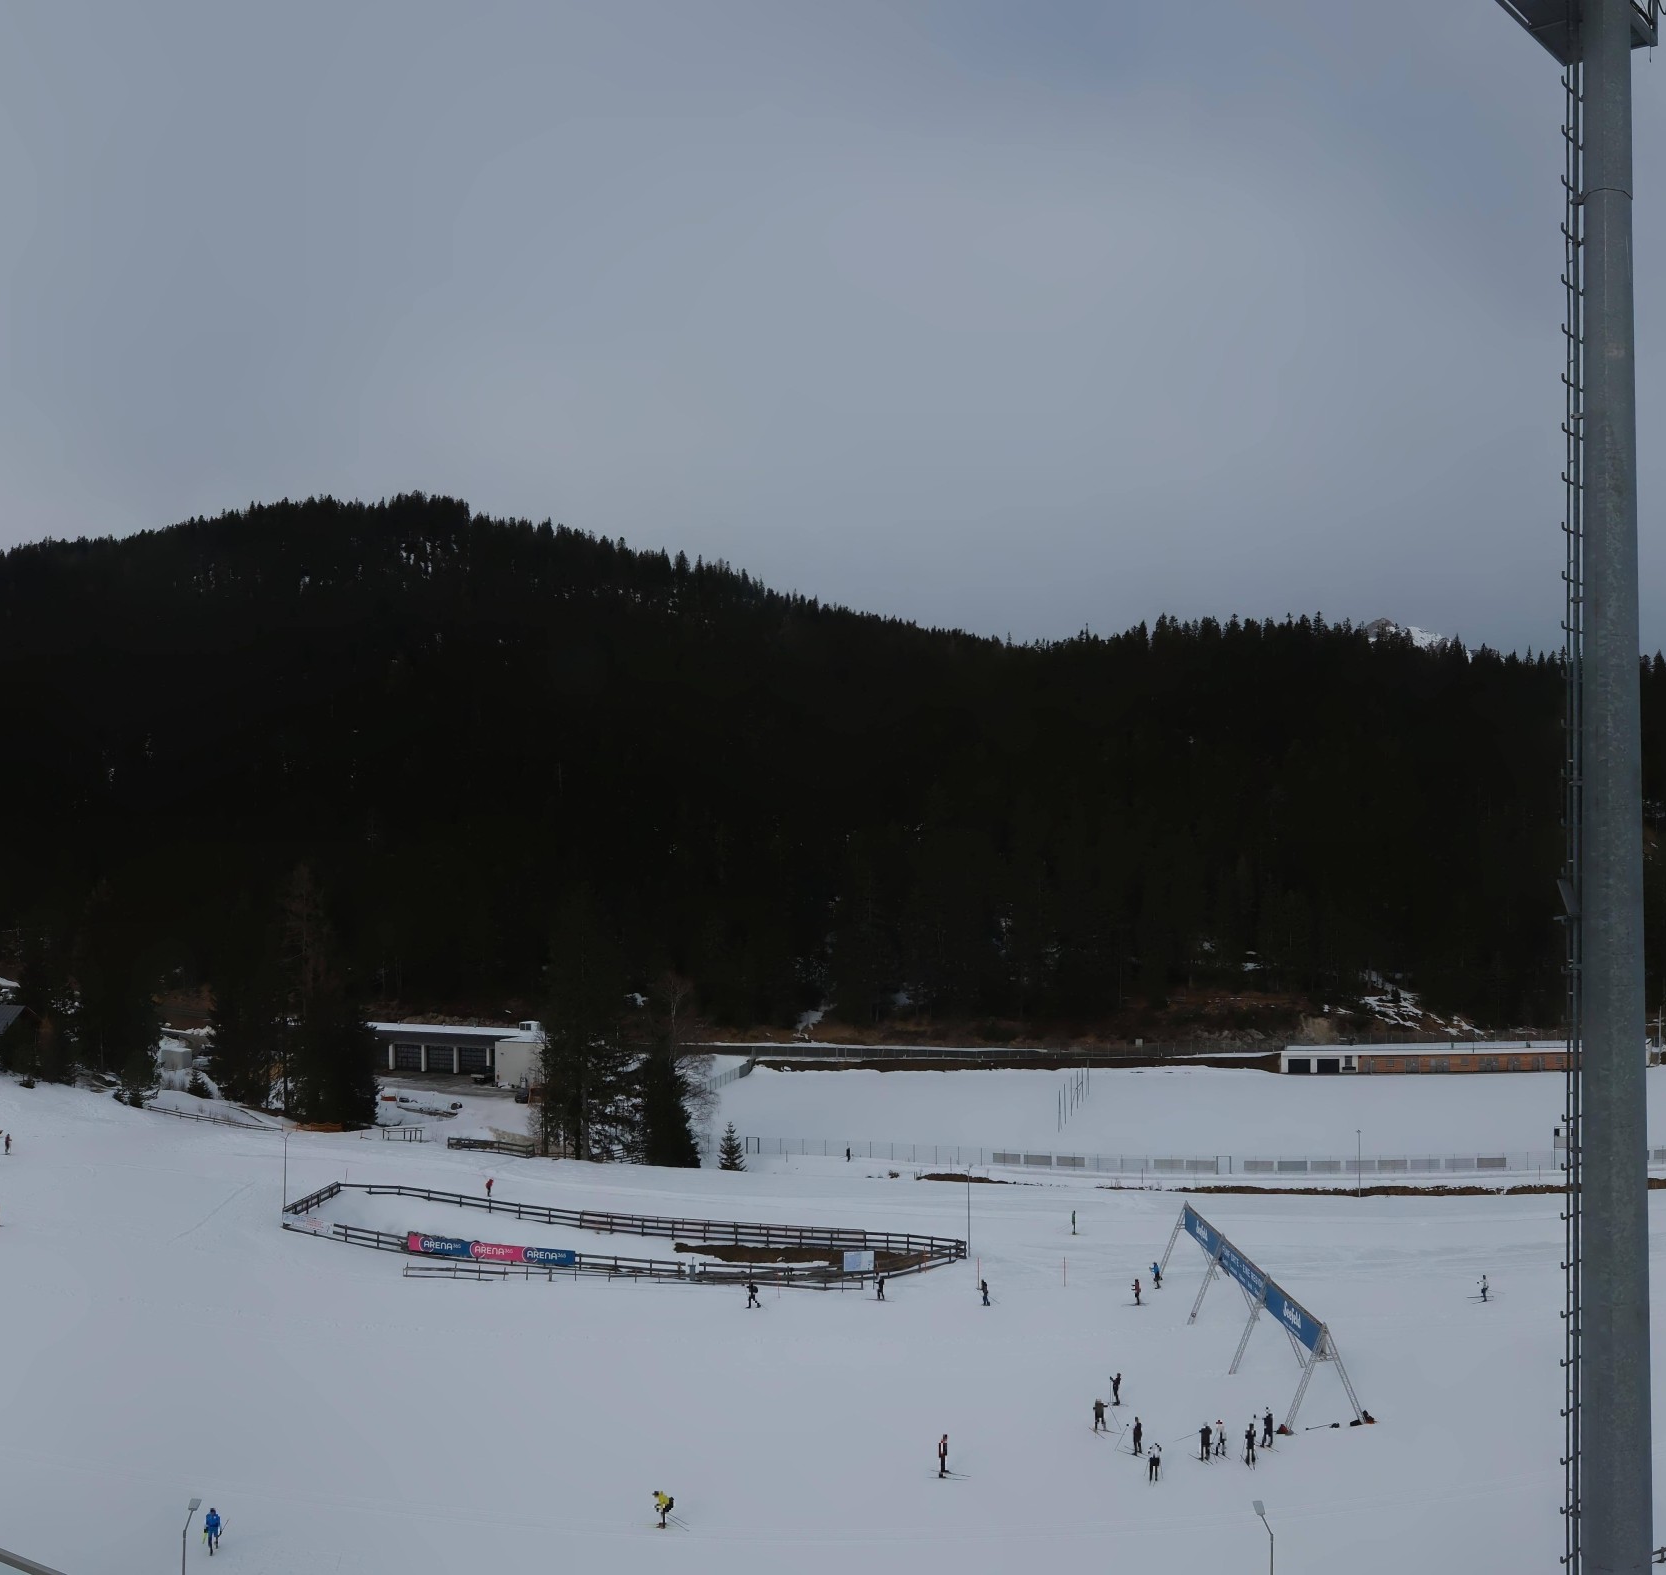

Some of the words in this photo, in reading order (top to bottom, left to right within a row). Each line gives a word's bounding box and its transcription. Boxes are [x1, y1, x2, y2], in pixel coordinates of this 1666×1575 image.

[423, 1240, 453, 1250] ARENA
[475, 1245, 505, 1255] ARENA
[527, 1250, 558, 1259] ARENA
